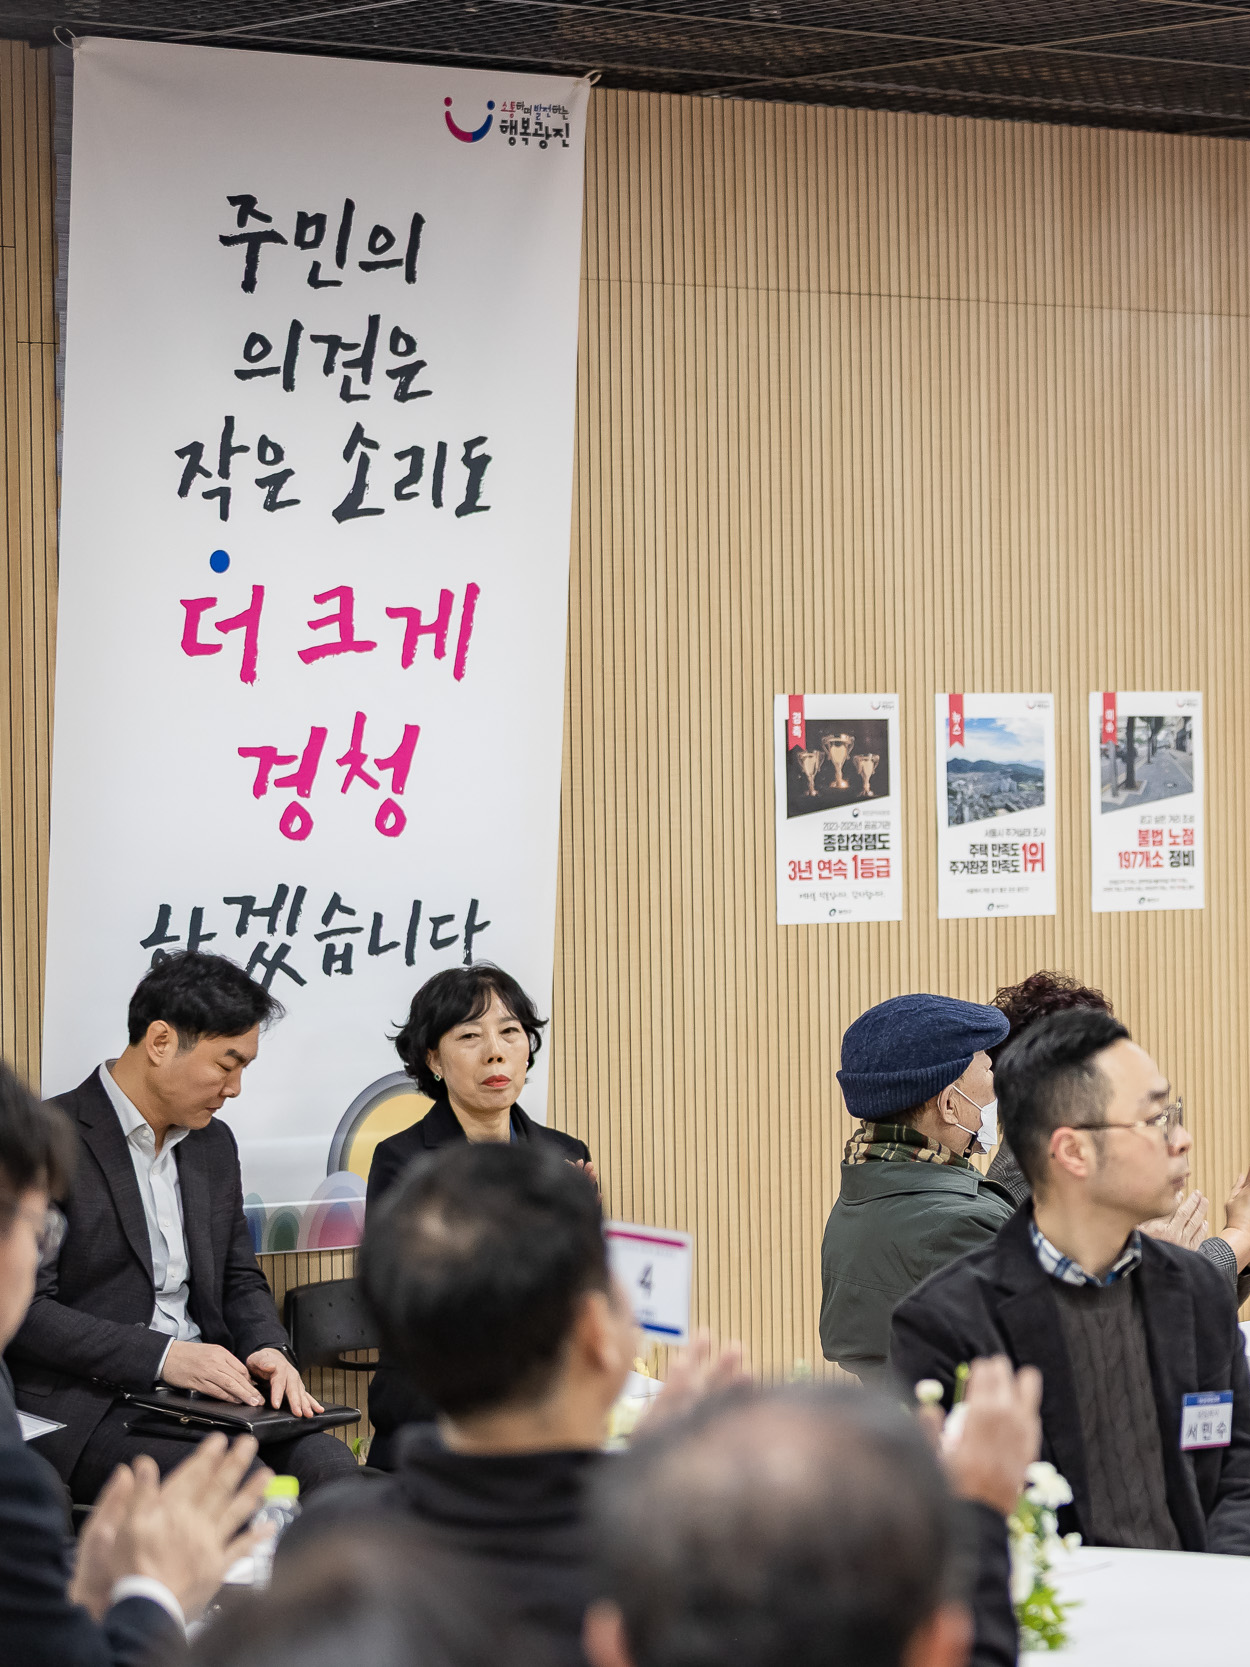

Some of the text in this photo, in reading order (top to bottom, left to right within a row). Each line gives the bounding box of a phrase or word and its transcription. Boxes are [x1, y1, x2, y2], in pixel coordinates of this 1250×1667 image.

[500, 101, 569, 120] 소통하며 발전하는
[499, 117, 569, 149] 행복광진
[218, 193, 425, 294] 주민의
[234, 313, 433, 403] 의견은
[174, 415, 493, 524] 작은 소리도
[180, 582, 480, 687] 더 크게
[238, 711, 421, 841] 경청
[823, 833, 890, 852] 종합청렴도
[1138, 829, 1194, 847] 불법 노점
[788, 855, 890, 881] 3년 연속 1등급
[949, 860, 1020, 875] 주거환경 만족도
[970, 842, 1045, 872] 주택 만족도 1위
[1118, 850, 1194, 869] 197개소 정비
[638, 1264, 654, 1298] 4
[1186, 1421, 1227, 1441] 서민수
